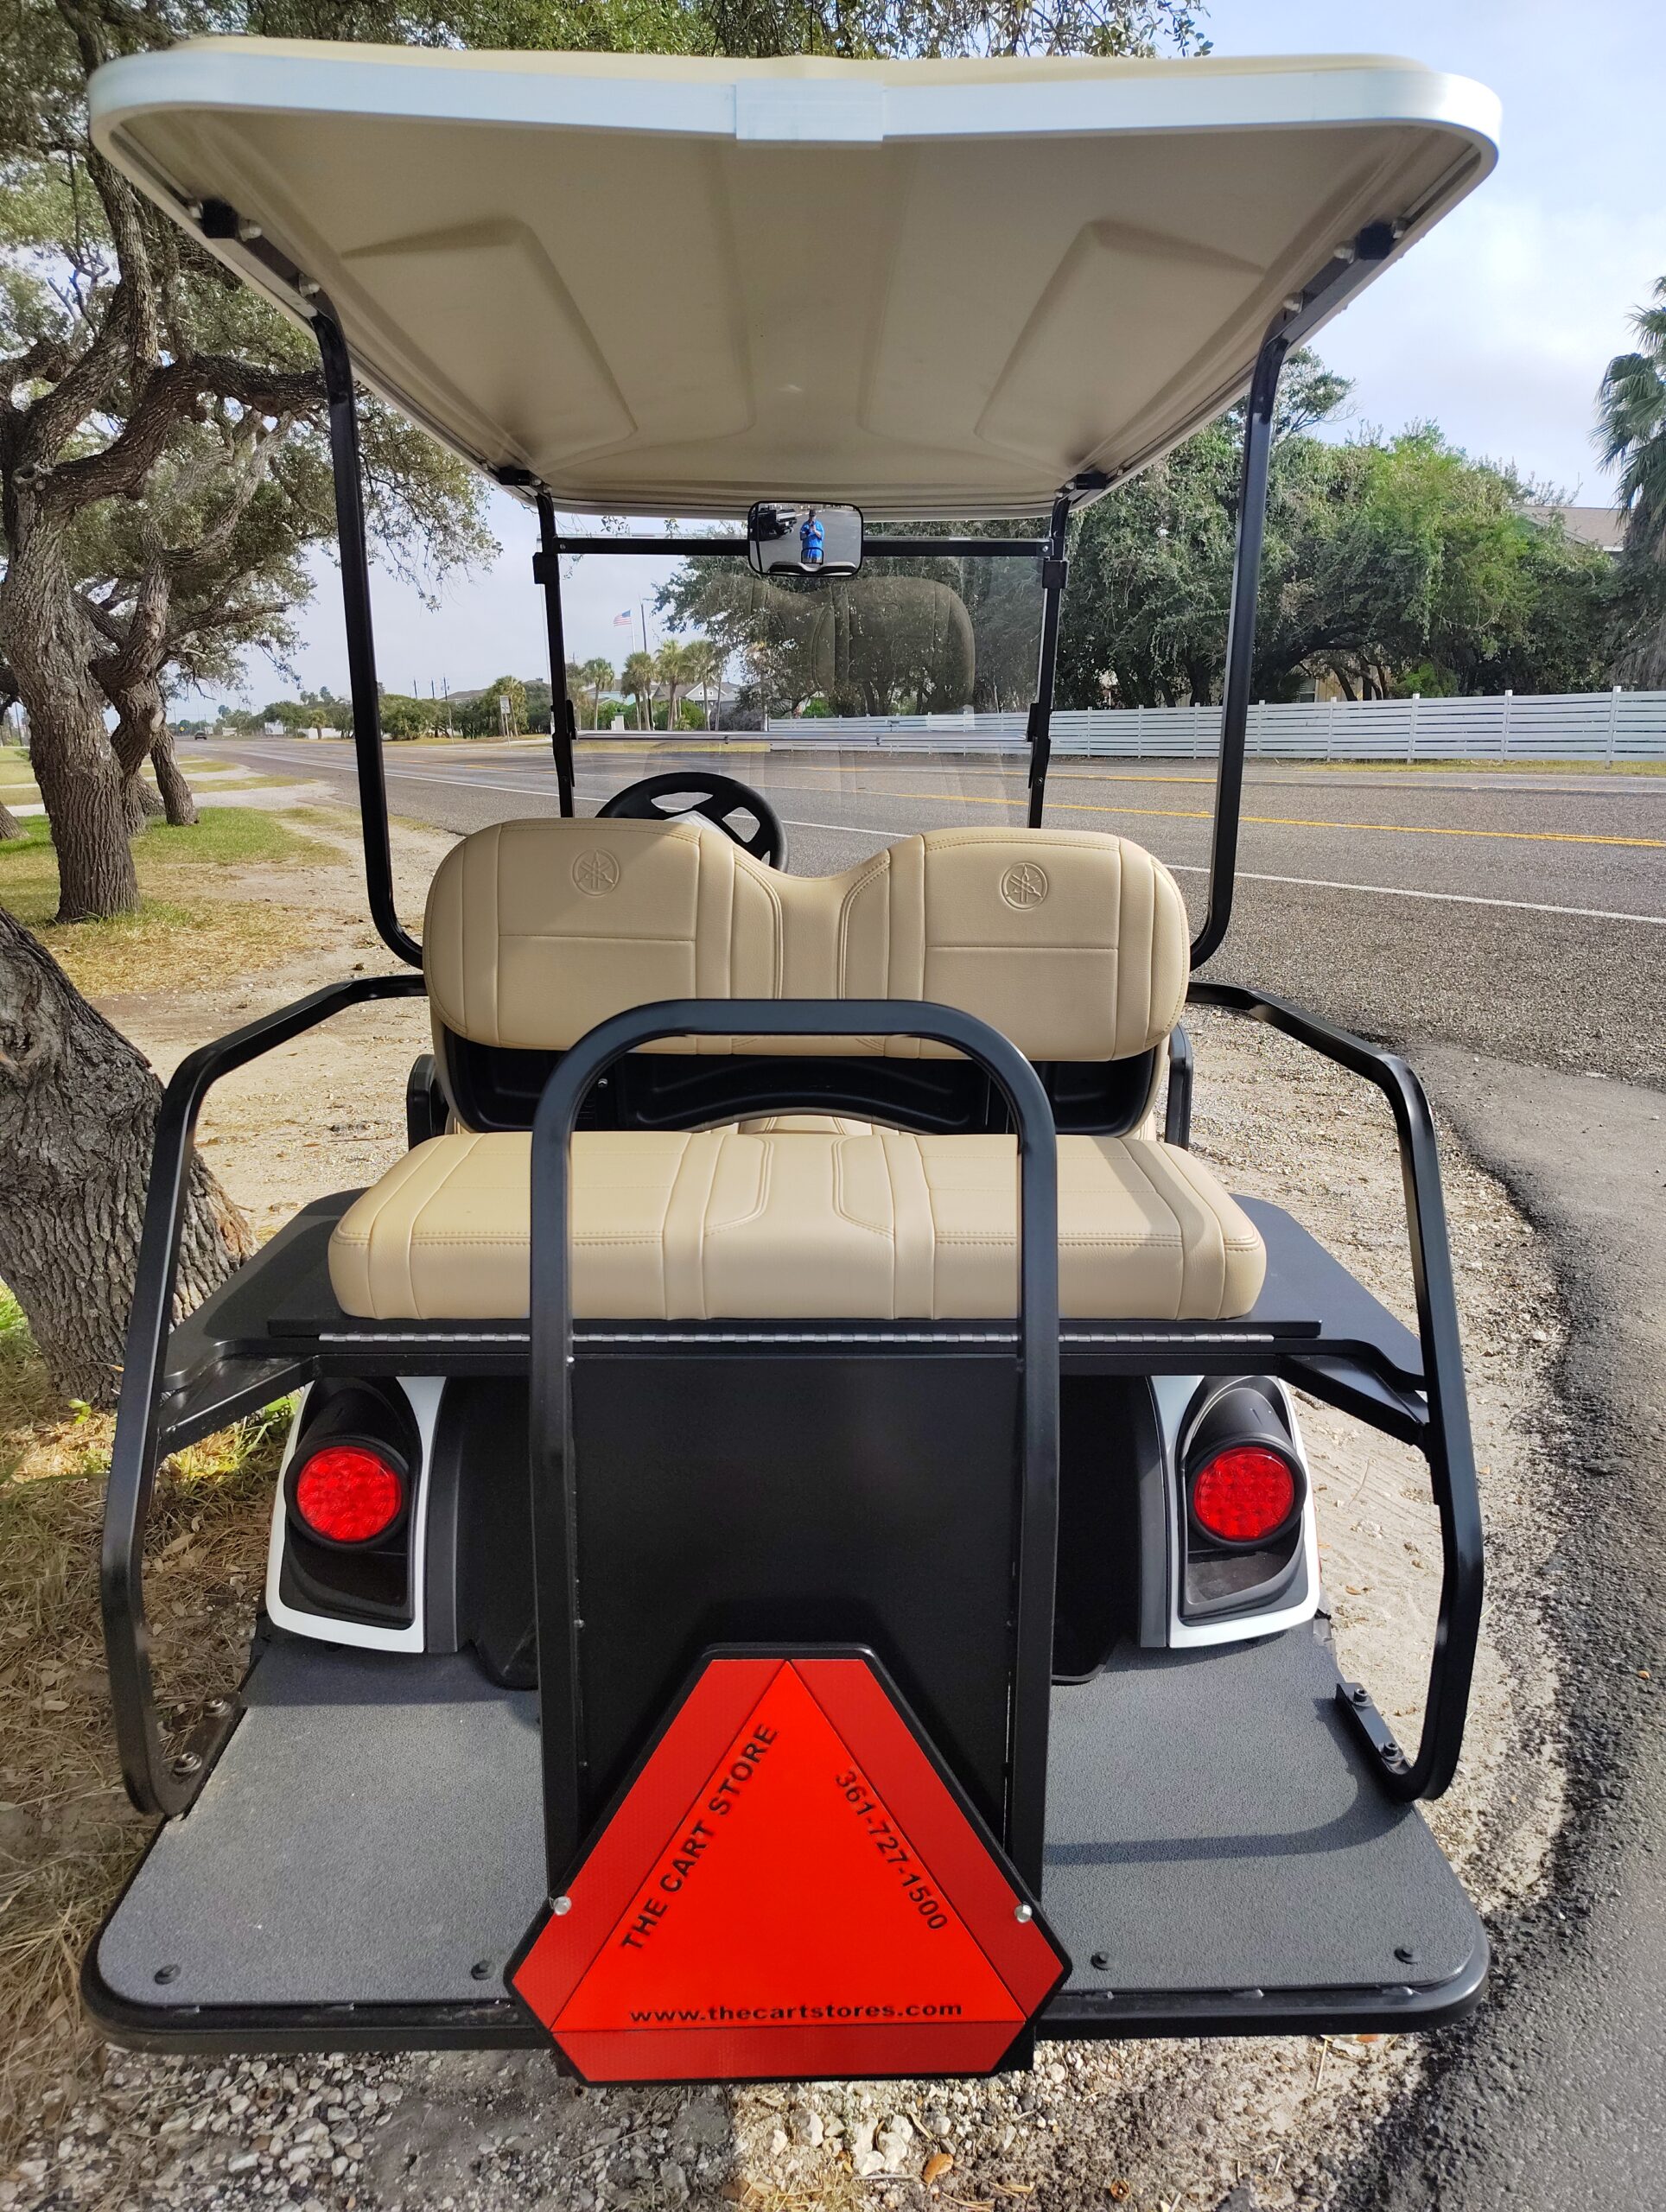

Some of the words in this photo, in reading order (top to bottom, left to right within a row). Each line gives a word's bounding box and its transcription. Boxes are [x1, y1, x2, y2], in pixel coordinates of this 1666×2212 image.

[620, 1898, 668, 1949] THE
[659, 1820, 715, 1893] CART
[708, 1723, 779, 1815] STORE
[835, 1770, 948, 1929] 361-727-1500
[630, 2004, 962, 2022] www.thecartstores.com
